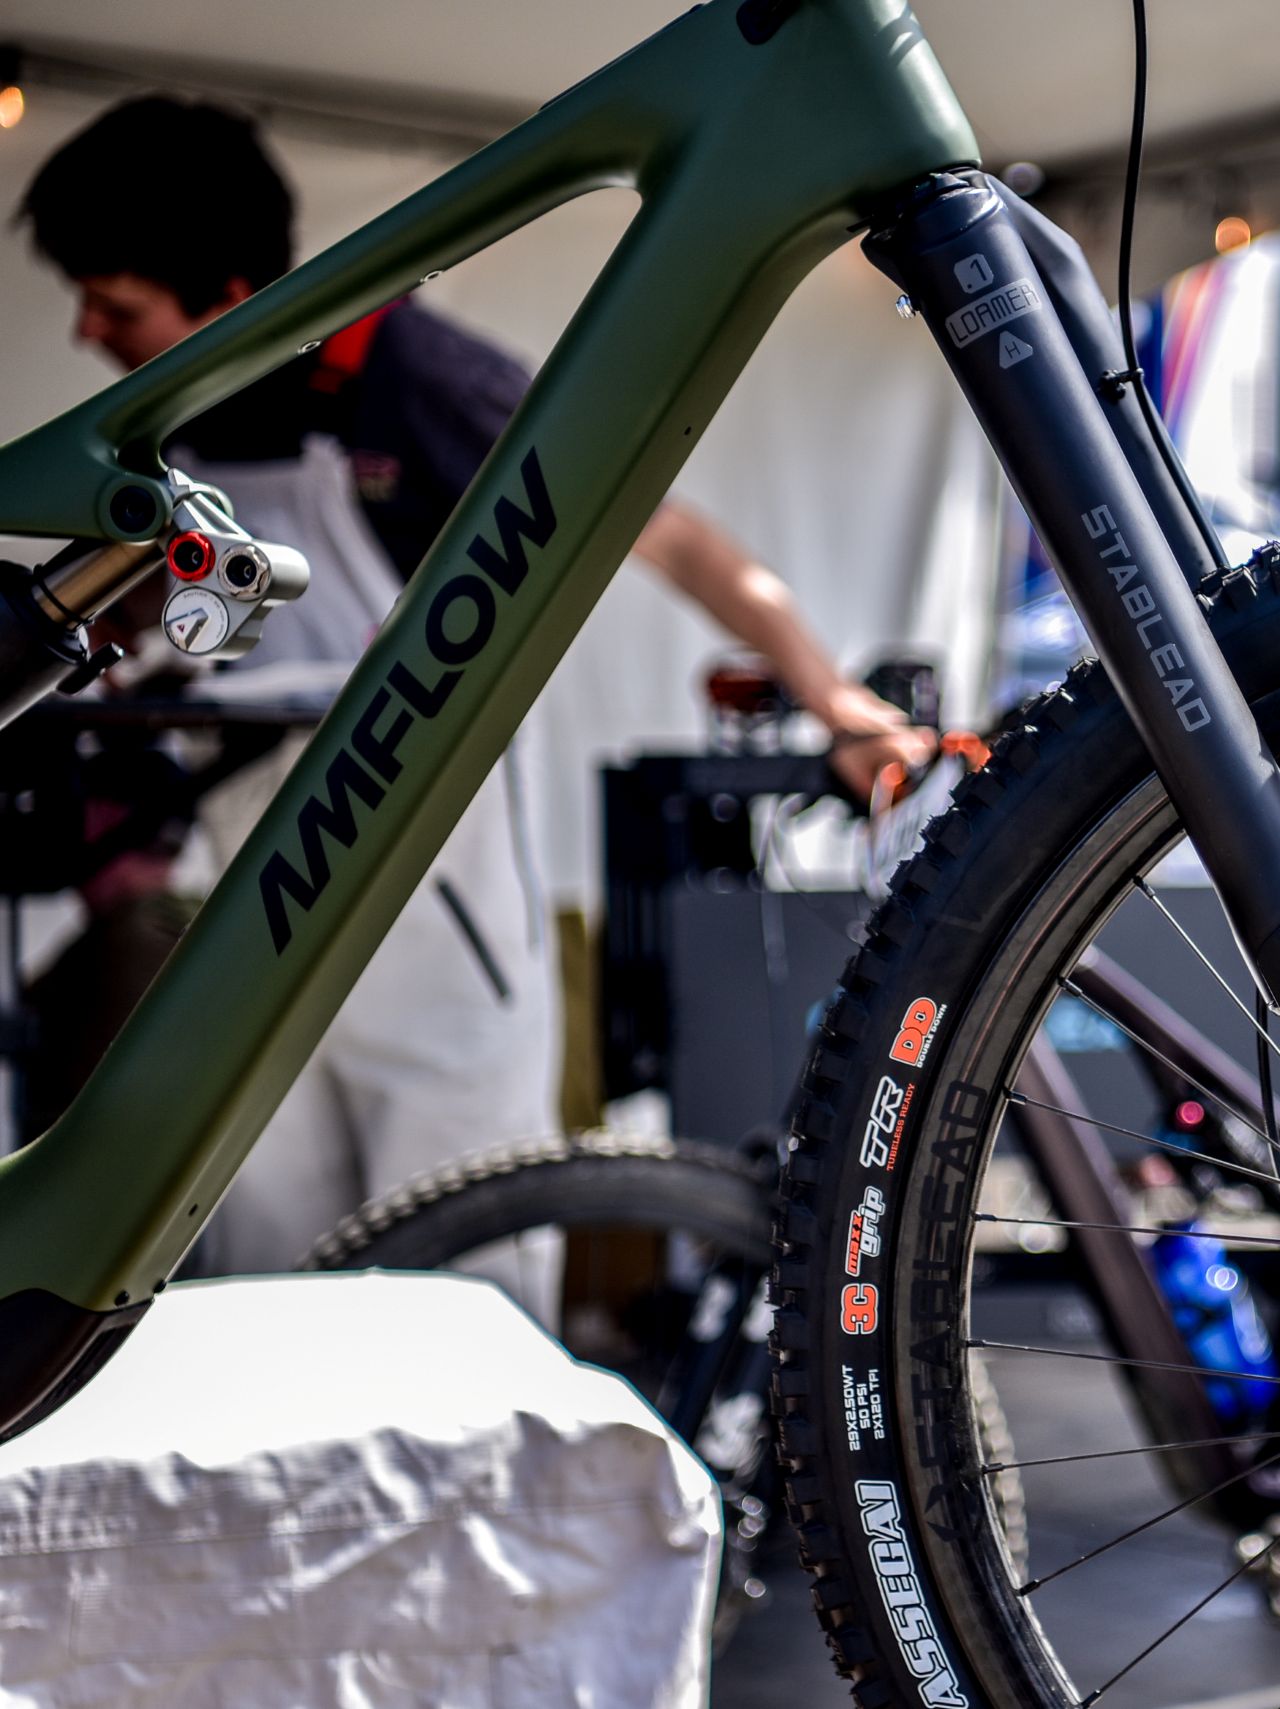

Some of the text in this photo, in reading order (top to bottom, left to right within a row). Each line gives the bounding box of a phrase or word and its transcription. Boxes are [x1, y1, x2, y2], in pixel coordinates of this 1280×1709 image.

[949, 284, 1039, 343] LOAMER
[1004, 341, 1021, 359] H
[1081, 504, 1212, 733] STABLEAD
[258, 445, 558, 957] AMFLOW
[888, 996, 938, 1067] DD
[916, 1003, 948, 1069] DOUBLE DOWN
[858, 1075, 905, 1168] TR
[886, 1082, 916, 1172] TUBELESS READY
[858, 1185, 886, 1257] grip
[840, 1283, 879, 1335] 3C
[909, 1078, 988, 1469] STABLEAD
[856, 1383, 871, 1430] 50 PSI
[868, 1368, 886, 1440] 2X120 TPI
[854, 1479, 970, 1709] ASSEGAI
